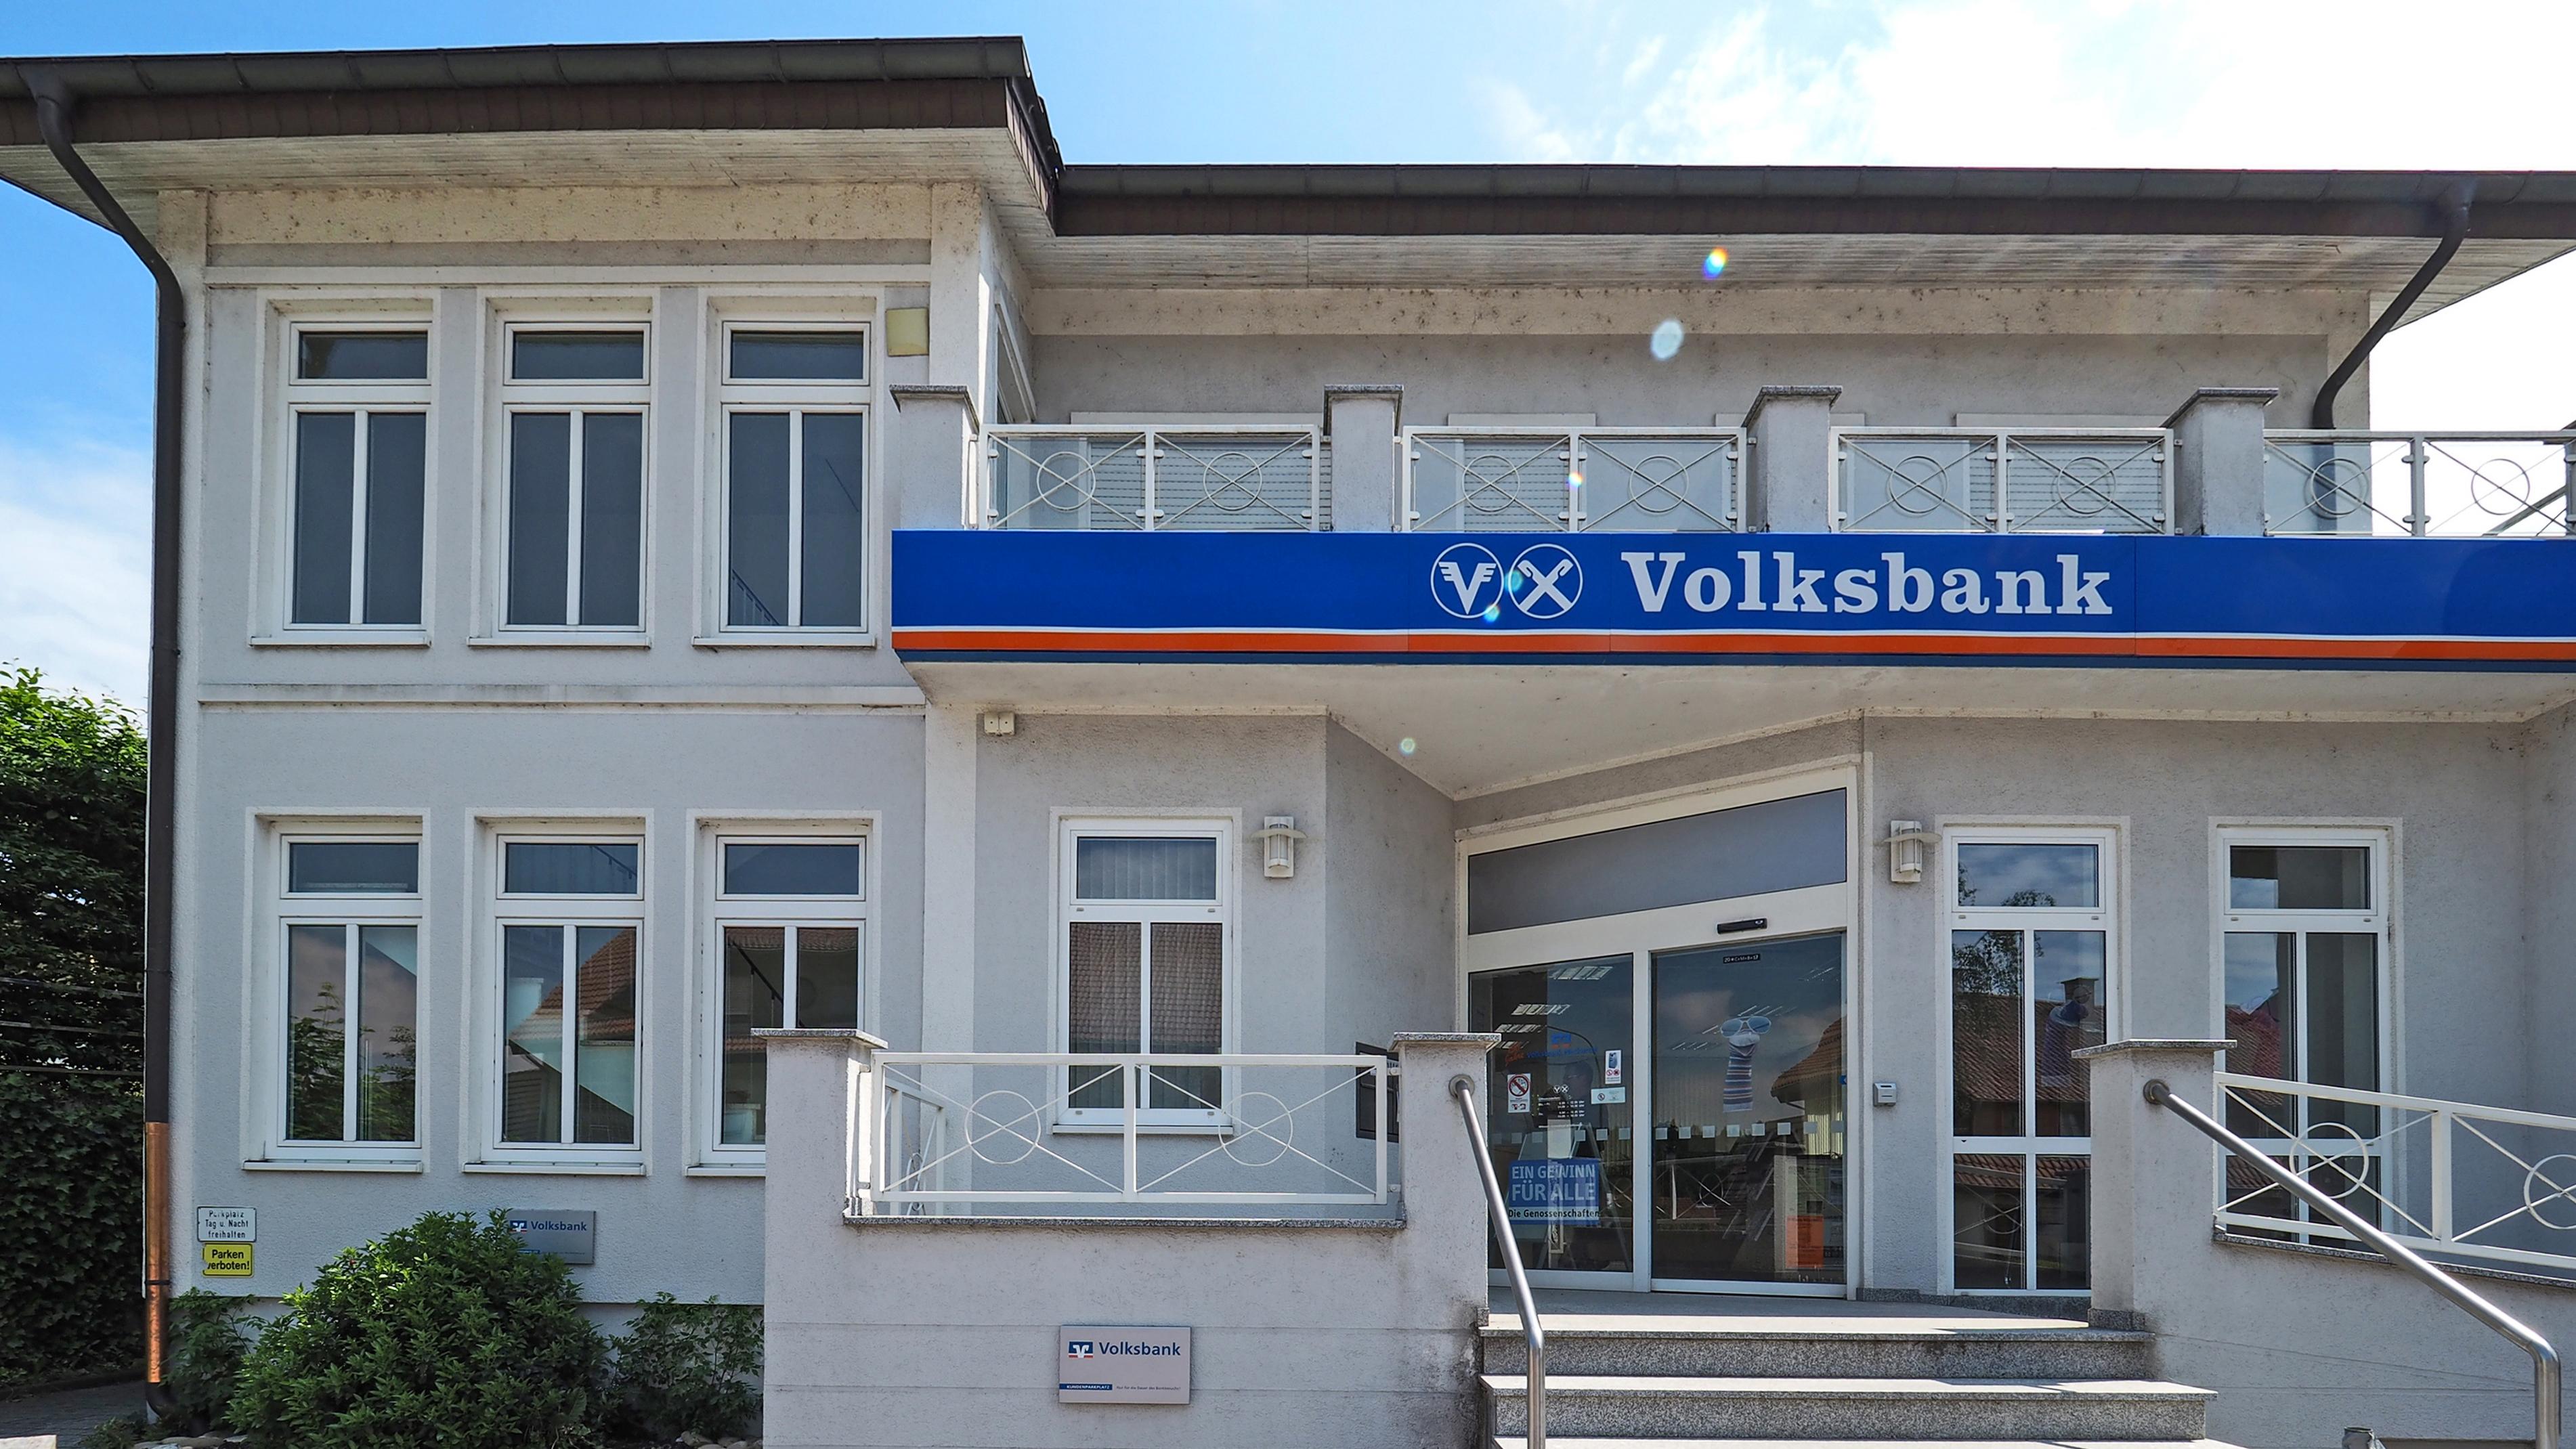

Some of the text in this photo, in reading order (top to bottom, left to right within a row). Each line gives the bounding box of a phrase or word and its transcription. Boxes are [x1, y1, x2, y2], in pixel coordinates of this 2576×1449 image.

[1620, 550, 2113, 617] Volksbank
[1512, 1164, 1595, 1179] EIN GEWINN
[1512, 1180, 1595, 1201] FÜR ALLE
[1509, 1209, 1600, 1218] Die Genossenschaften
[205, 1219, 217, 1229] Tag
[228, 1219, 249, 1228] Nacht
[530, 1221, 587, 1231] Volksbank
[208, 1230, 246, 1238] freihalten
[211, 1249, 244, 1259] Parken
[1098, 1341, 1181, 1356] Volksbank
